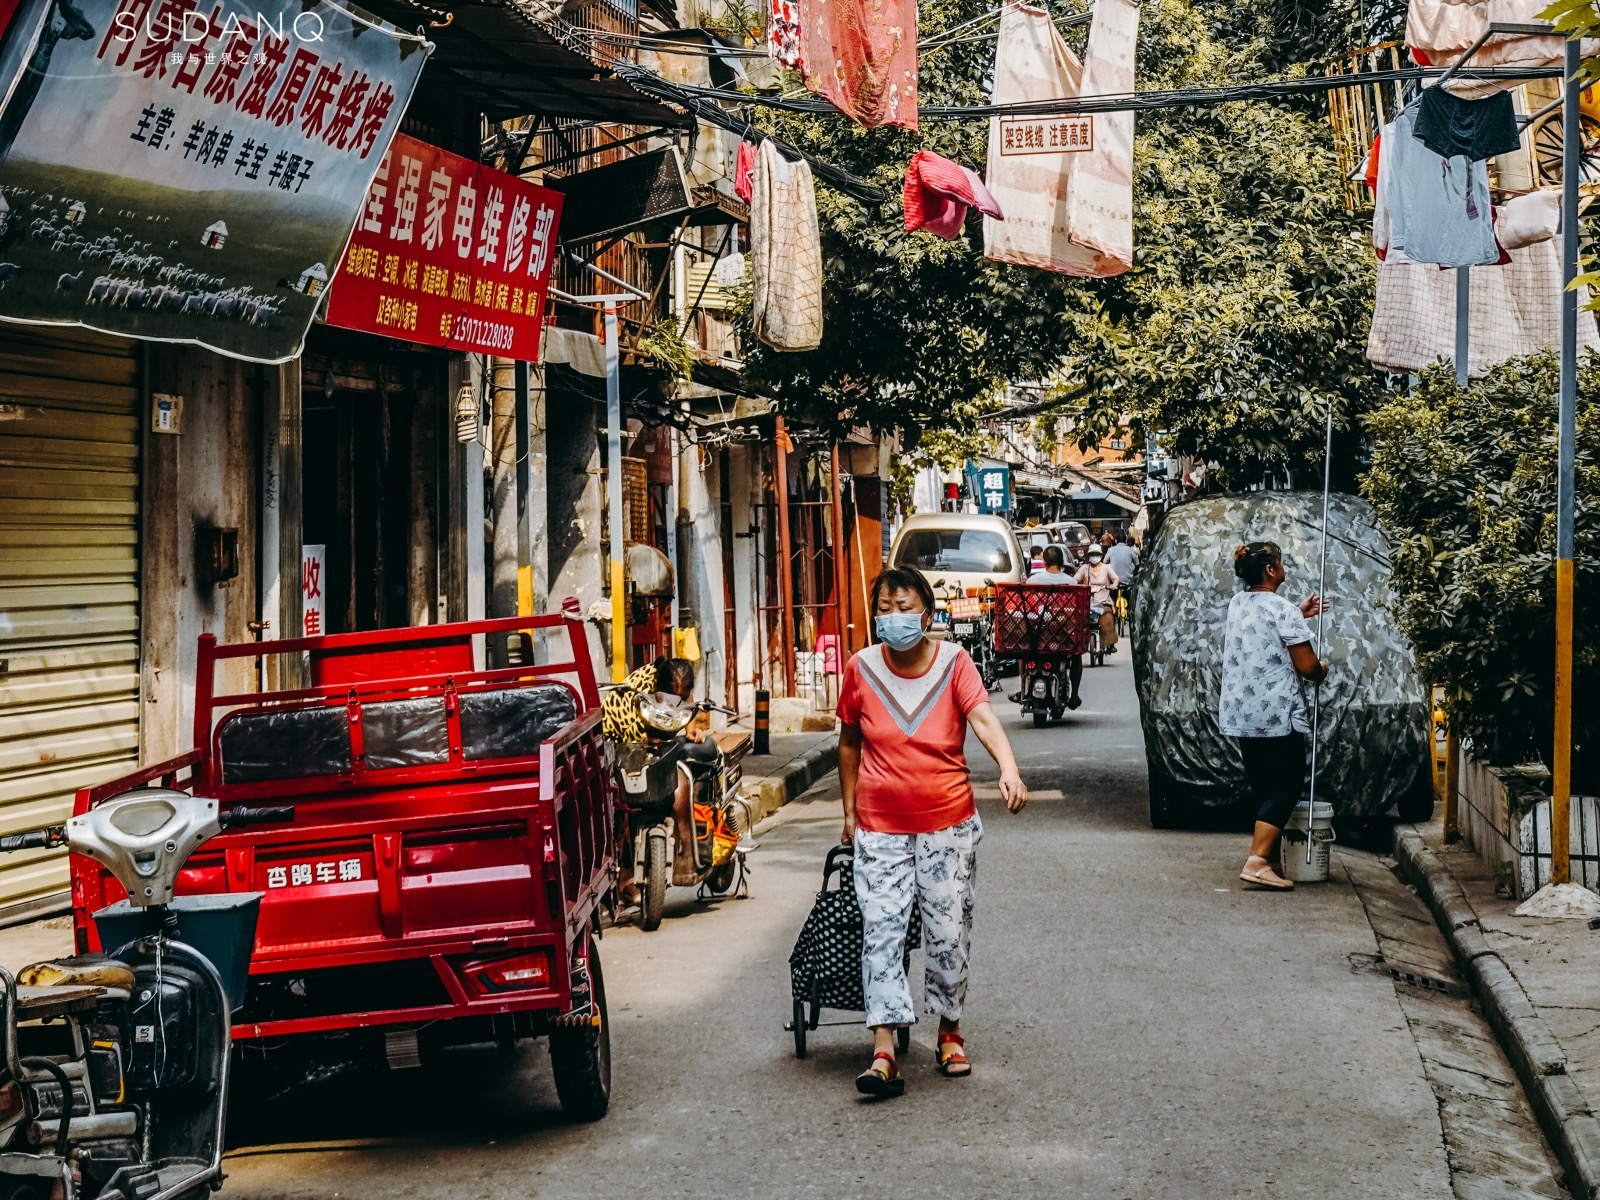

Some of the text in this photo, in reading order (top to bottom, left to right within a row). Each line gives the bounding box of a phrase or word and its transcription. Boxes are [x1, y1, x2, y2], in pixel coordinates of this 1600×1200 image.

[1005, 121, 1089, 150] 架空线缆 注意高度
[375, 295, 419, 331] 及各种小家电
[983, 472, 1004, 508] 超市
[267, 858, 362, 889] 杏鸽车辆
